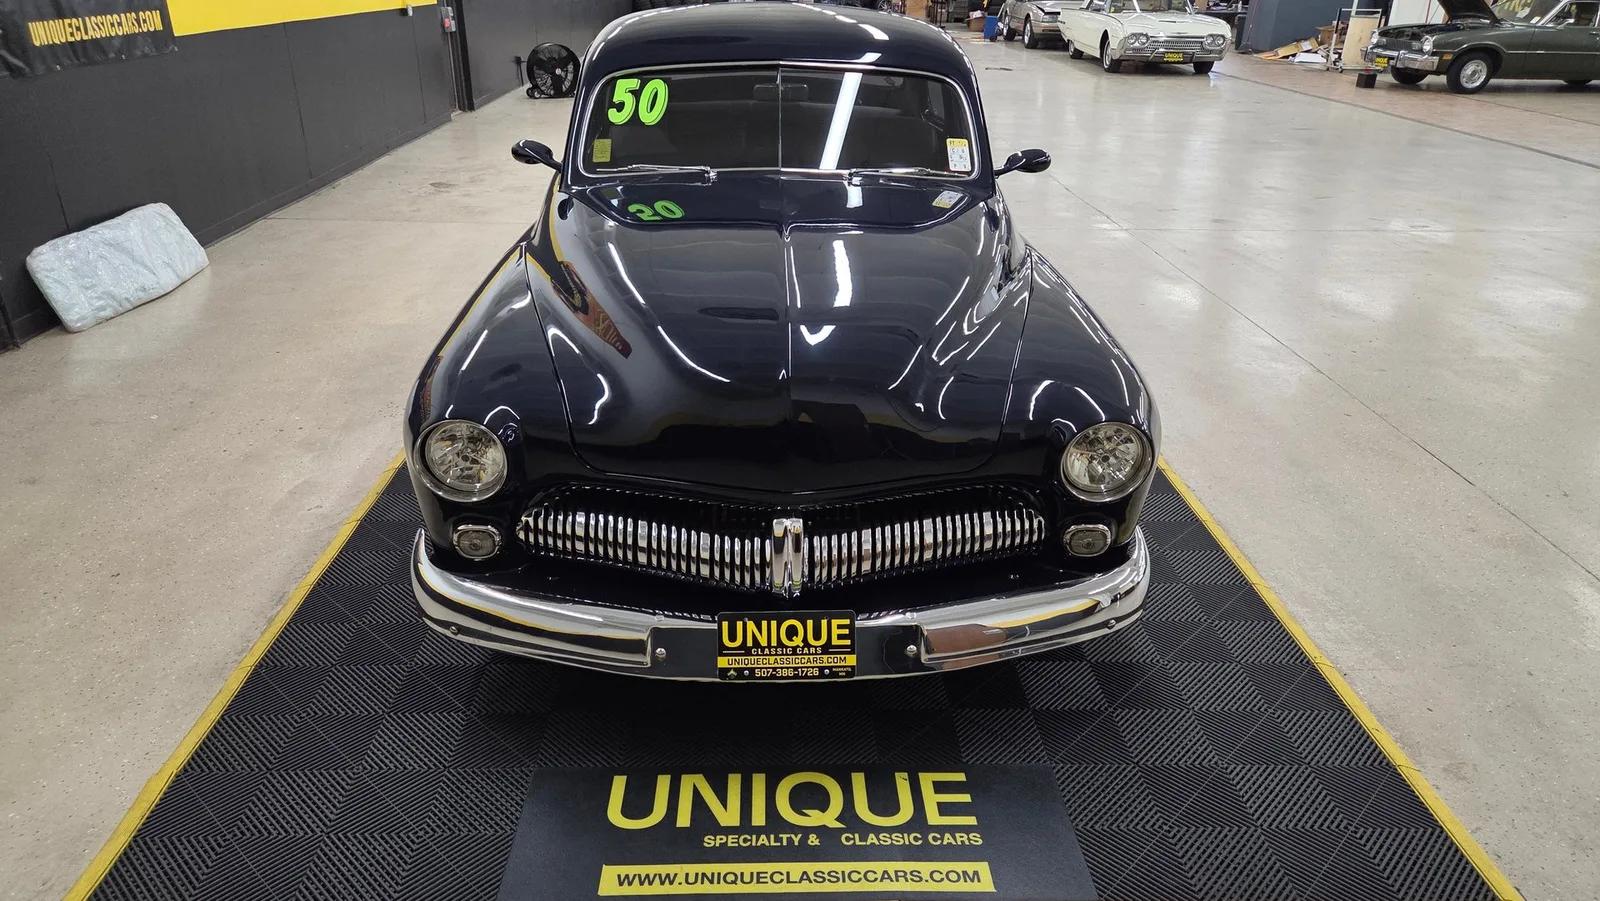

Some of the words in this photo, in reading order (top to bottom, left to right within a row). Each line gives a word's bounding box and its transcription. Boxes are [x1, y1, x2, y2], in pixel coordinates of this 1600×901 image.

[28, 10, 163, 47] UNIQUECLASSICCARS.COM
[607, 78, 670, 126] 50
[721, 619, 851, 648] UNIQUE
[727, 656, 847, 666] UNIQUECLASSICCARS.COM
[754, 668, 819, 677] 507-386-1726
[606, 771, 979, 830] UNIQUE
[703, 833, 801, 847] SPECIALTY
[807, 833, 820, 846] &
[841, 833, 923, 846] CLASSIC
[927, 832, 983, 846] CARS
[617, 869, 981, 887] WWW.UNIQUECLASSICCARS.COM
